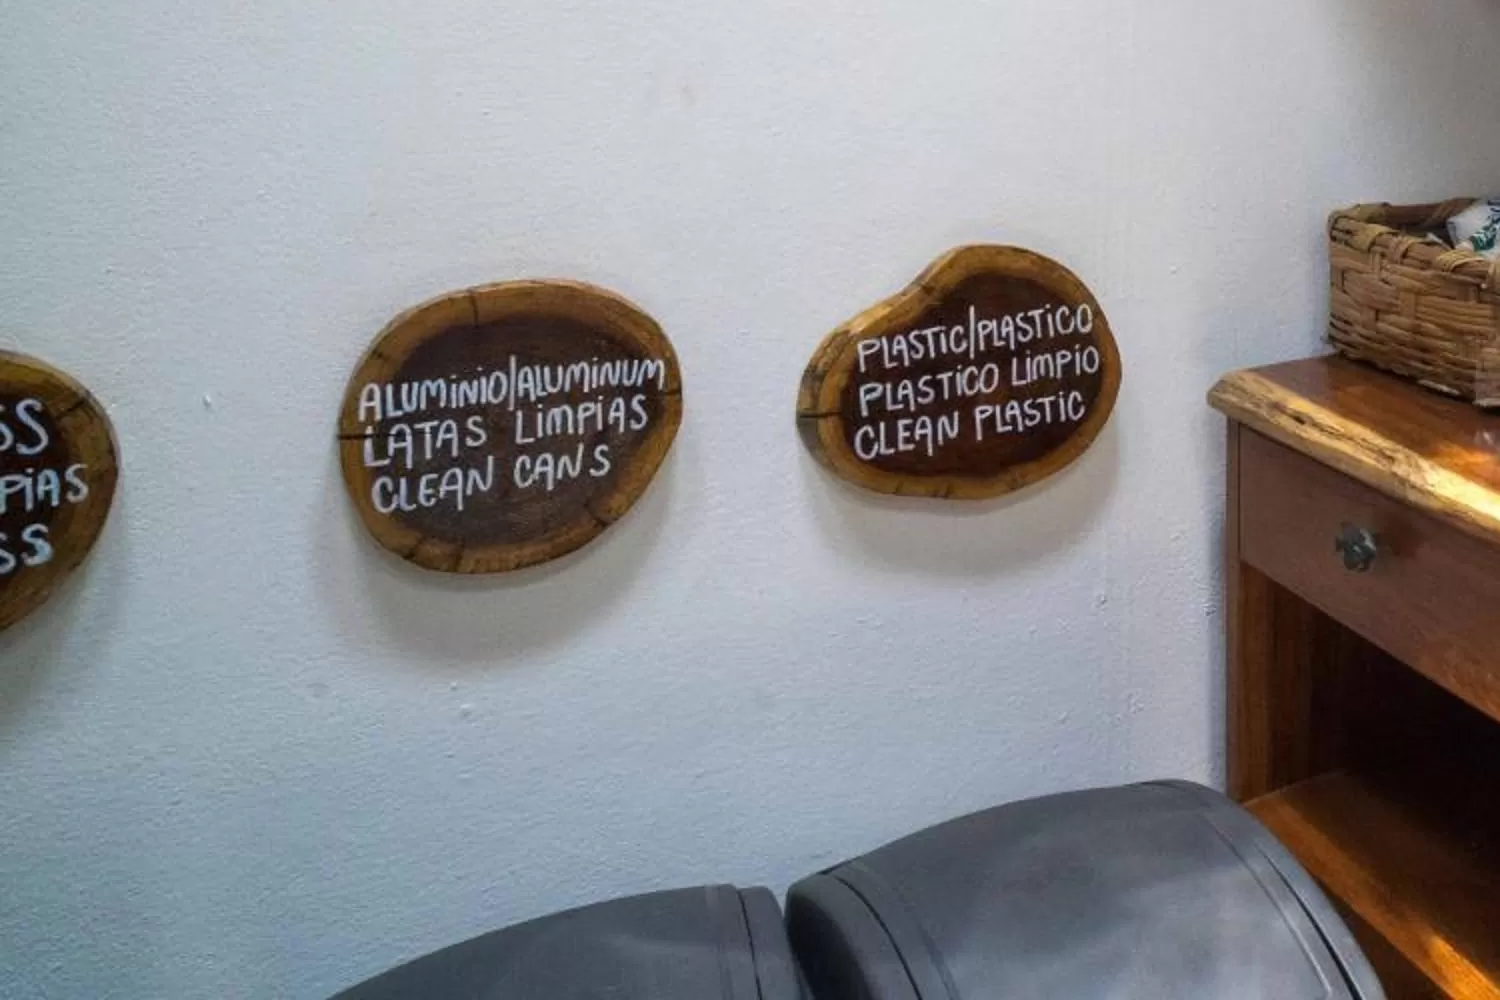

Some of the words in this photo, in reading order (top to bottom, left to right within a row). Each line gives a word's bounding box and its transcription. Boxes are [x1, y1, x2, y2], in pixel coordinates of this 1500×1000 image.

[363, 415, 488, 469] LATAS
[853, 411, 960, 460] CLEAN
[371, 455, 495, 514] CLEAN
[513, 443, 612, 491] CANS
